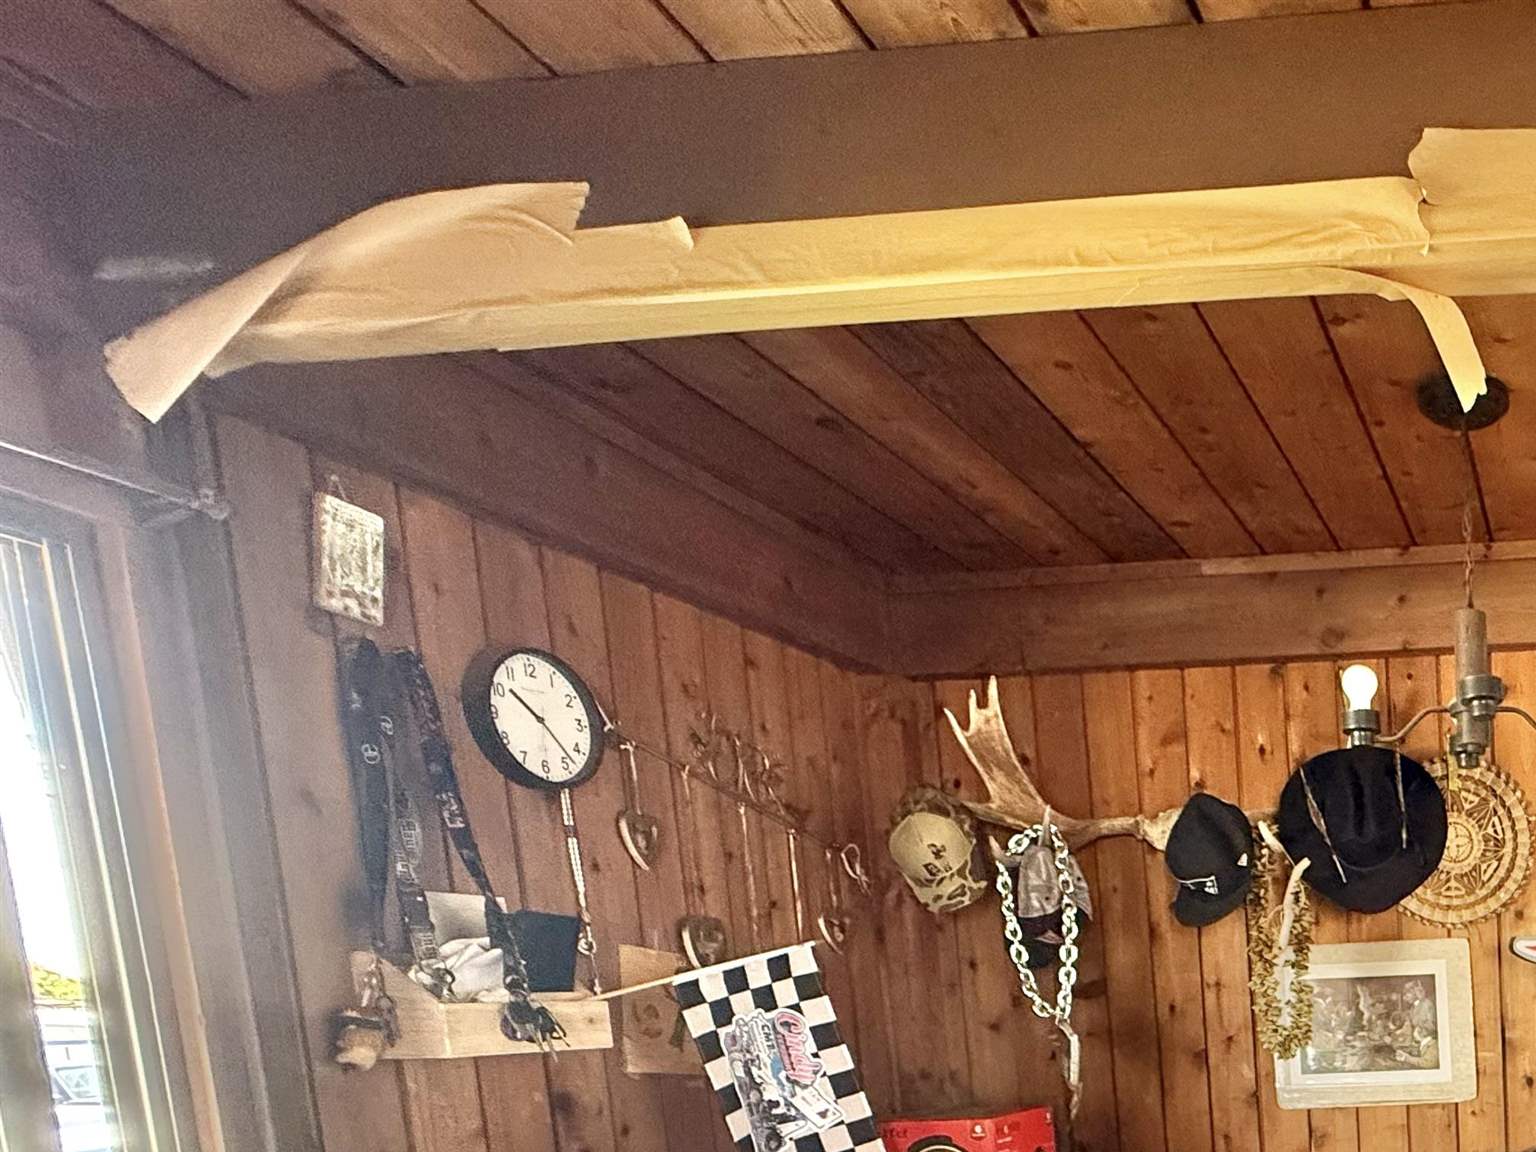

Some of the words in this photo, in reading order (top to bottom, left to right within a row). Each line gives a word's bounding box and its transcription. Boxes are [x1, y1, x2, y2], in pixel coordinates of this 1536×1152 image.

[506, 665, 515, 681] 11
[524, 663, 537, 679] 12
[492, 682, 505, 698] 10
[565, 694, 574, 708] 2
[574, 718, 584, 732] 3
[500, 731, 510, 746] 8
[573, 742, 581, 757] 4
[519, 750, 528, 765] 7
[561, 756, 570, 771] 5
[541, 760, 550, 774] 6
[775, 1012, 821, 1085] Cindy
